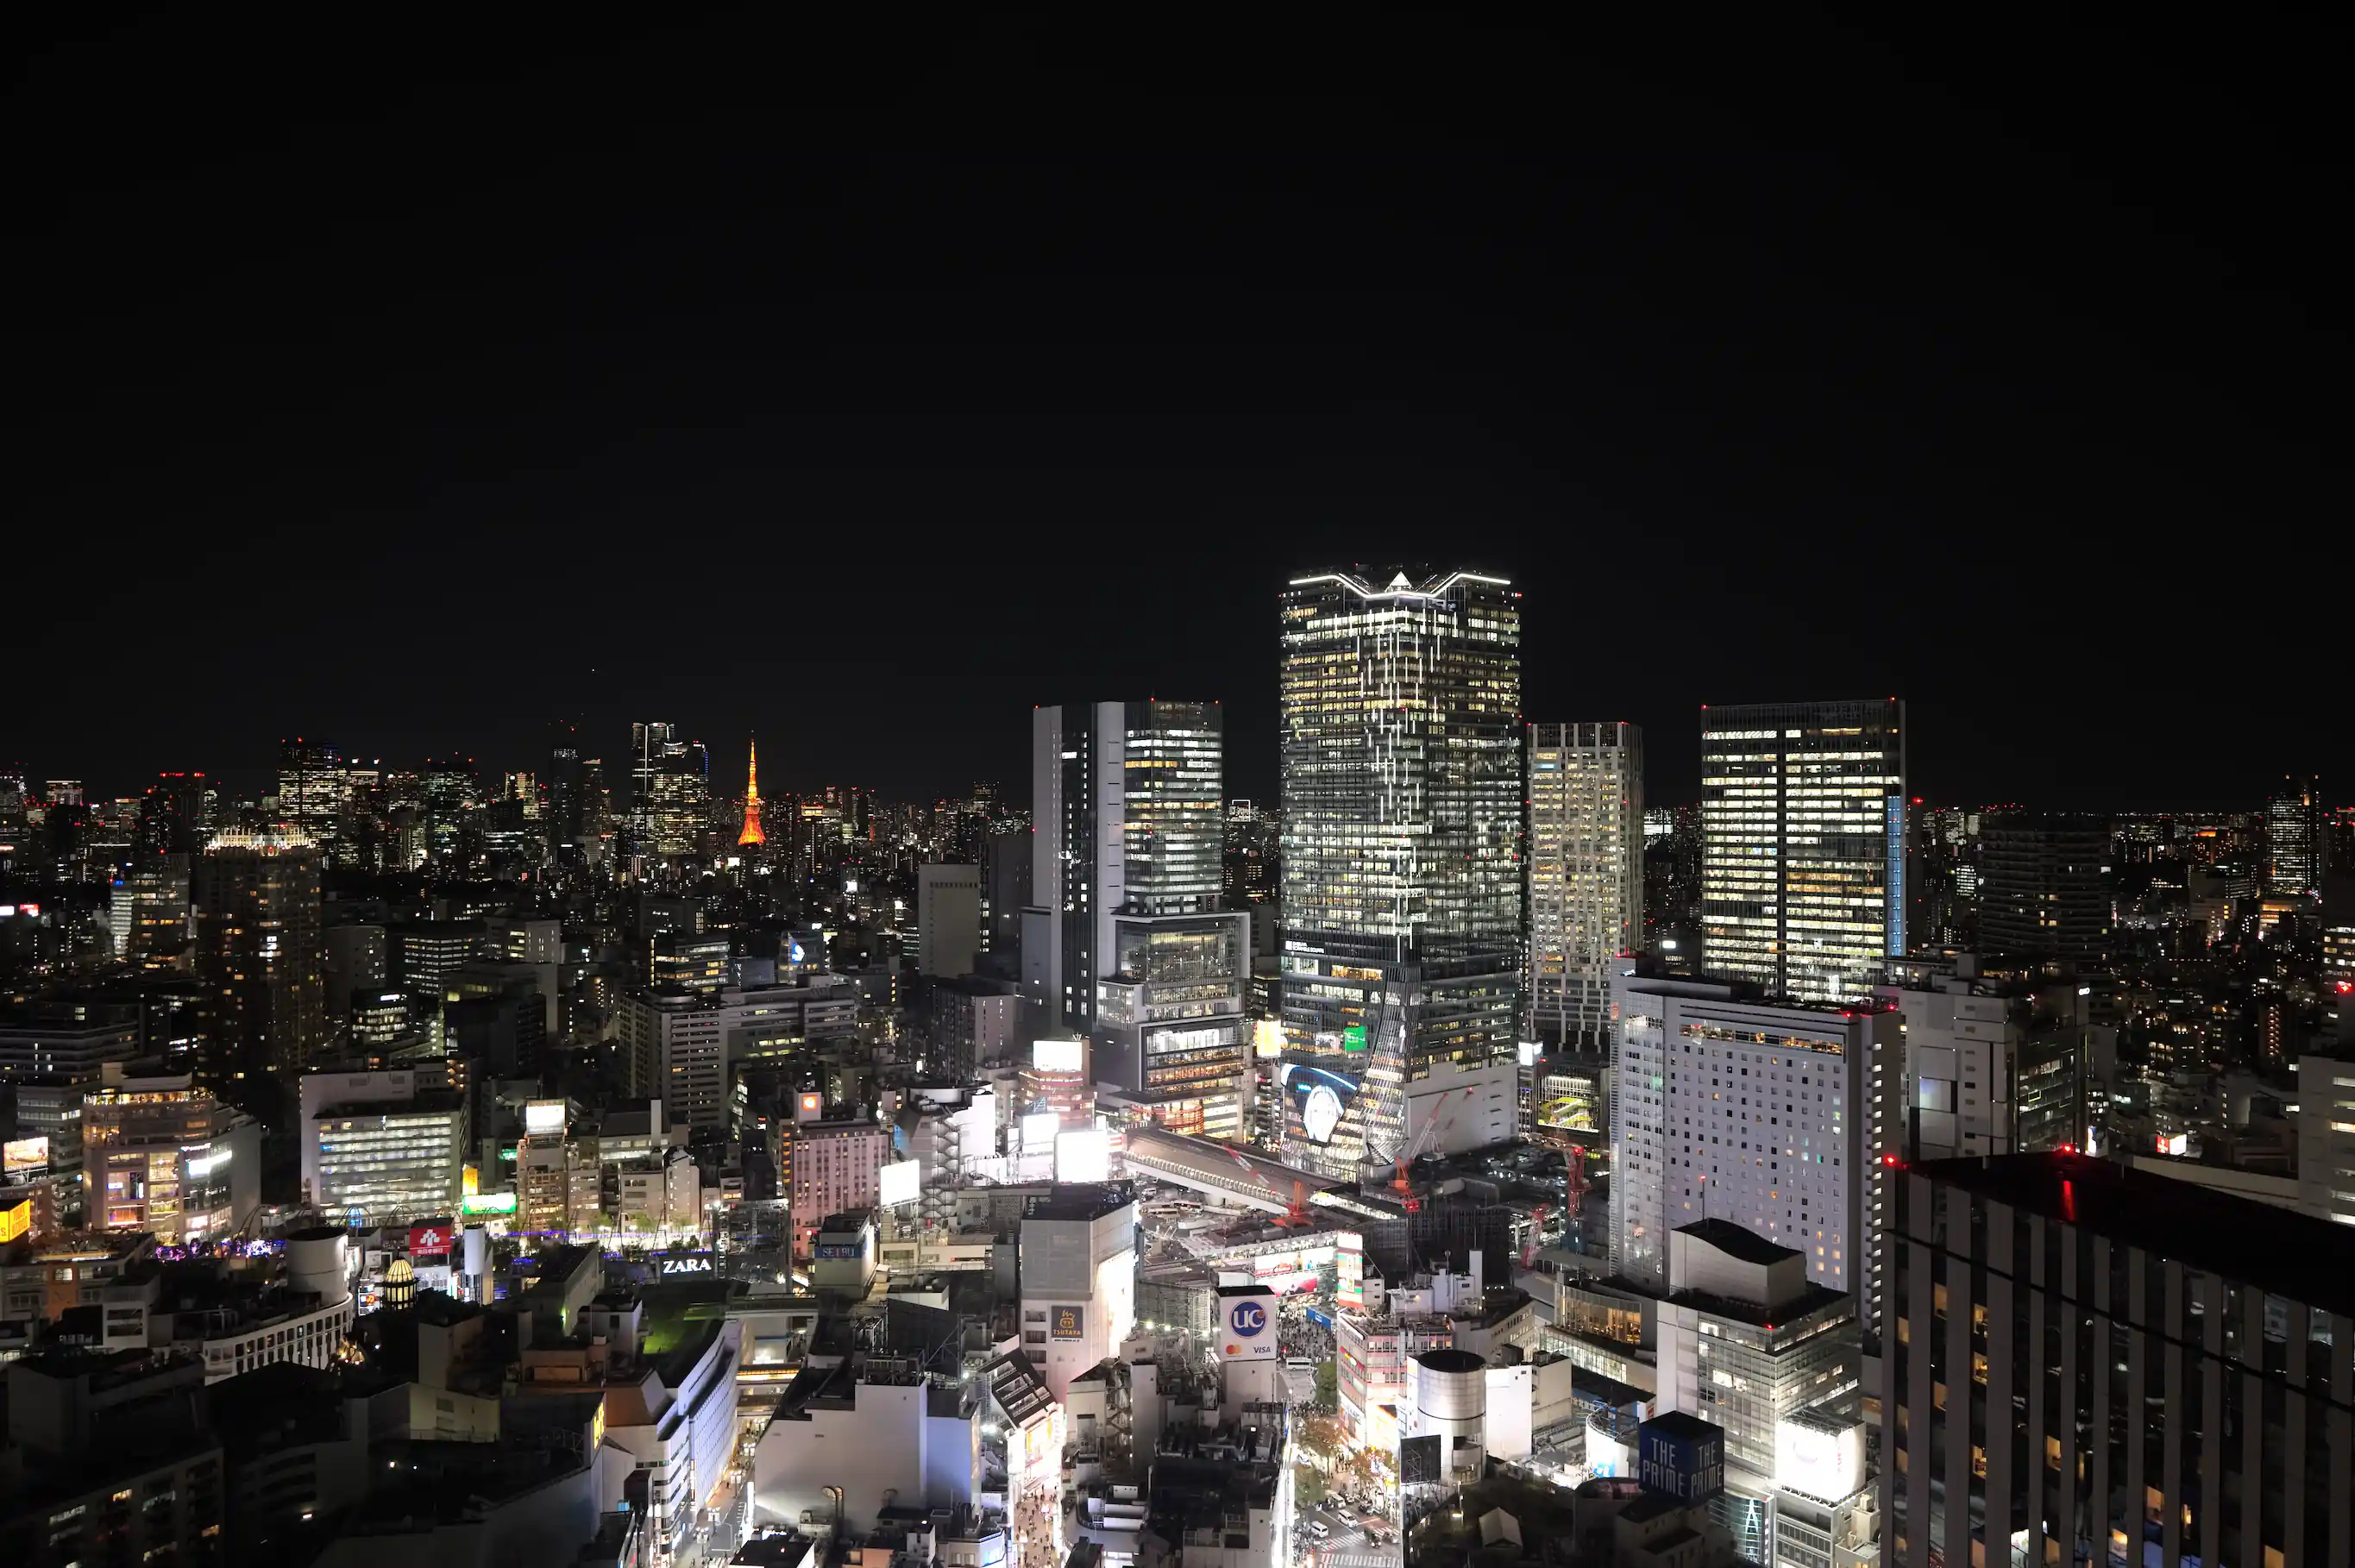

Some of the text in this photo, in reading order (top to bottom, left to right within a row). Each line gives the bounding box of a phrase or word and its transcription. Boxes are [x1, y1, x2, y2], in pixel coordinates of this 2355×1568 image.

[663, 1258, 712, 1274] ZARA
[822, 1247, 855, 1258] SEIBU
[1650, 1437, 1676, 1468] THE
[1698, 1440, 1716, 1469] THE
[1642, 1459, 1686, 1497] PRIME
[1691, 1464, 1722, 1498] PRIME
